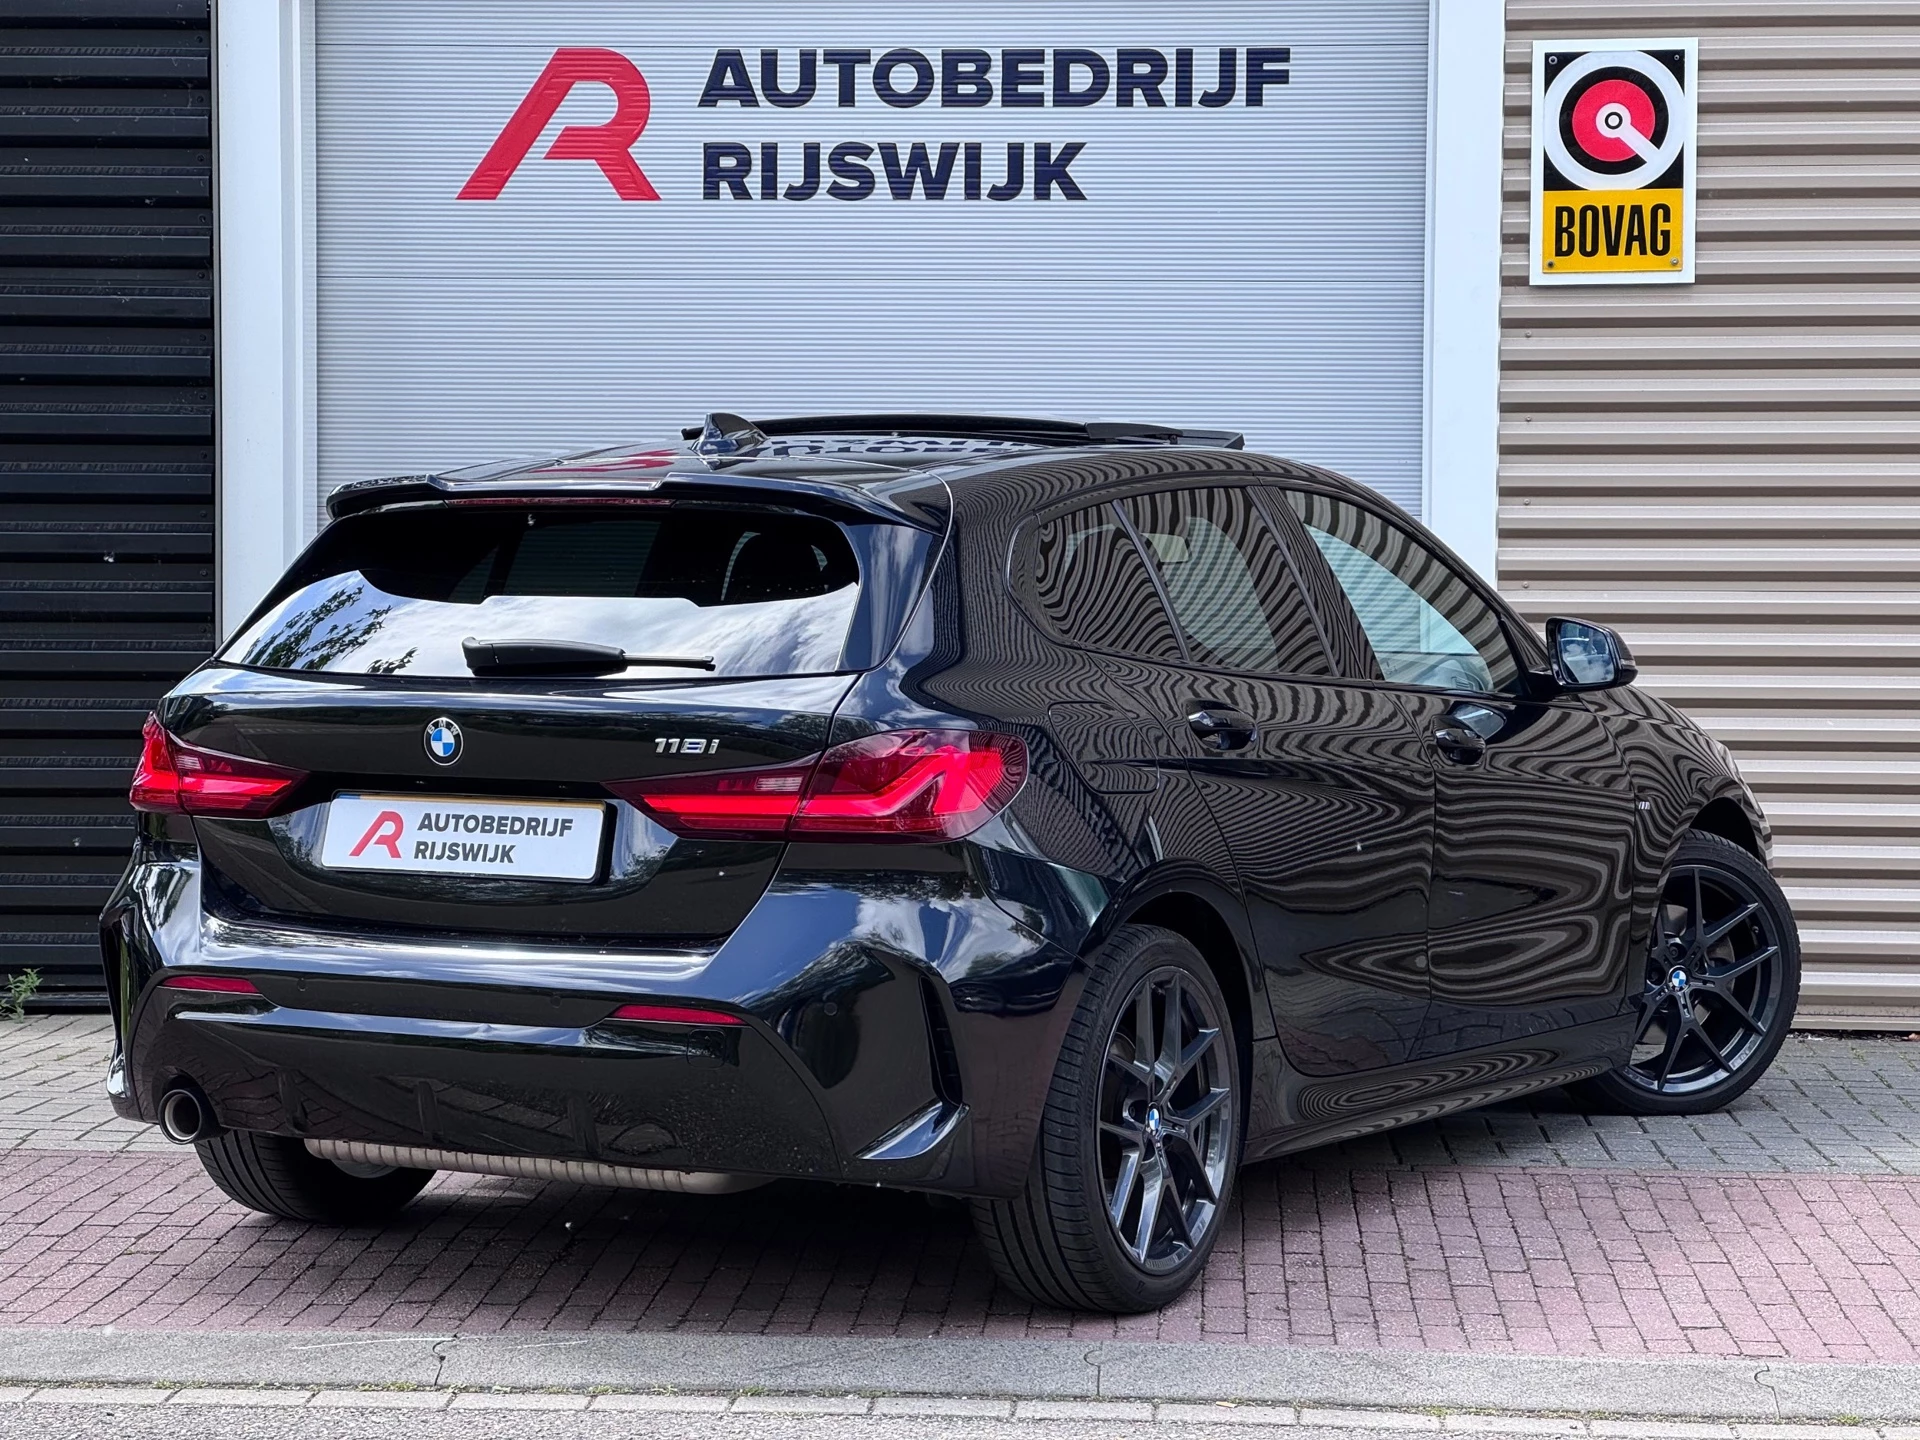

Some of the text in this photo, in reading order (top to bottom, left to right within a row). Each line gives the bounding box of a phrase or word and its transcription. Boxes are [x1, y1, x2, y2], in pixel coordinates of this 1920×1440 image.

[698, 48, 1290, 108] AUTOBEDRIJF
[702, 141, 1088, 201] RIJSWIJK
[1554, 204, 1671, 258] BOVAG
[654, 737, 720, 754] 118i
[417, 812, 574, 837] AUTOBEDRIJF
[414, 840, 516, 864] RIJSWIJK
